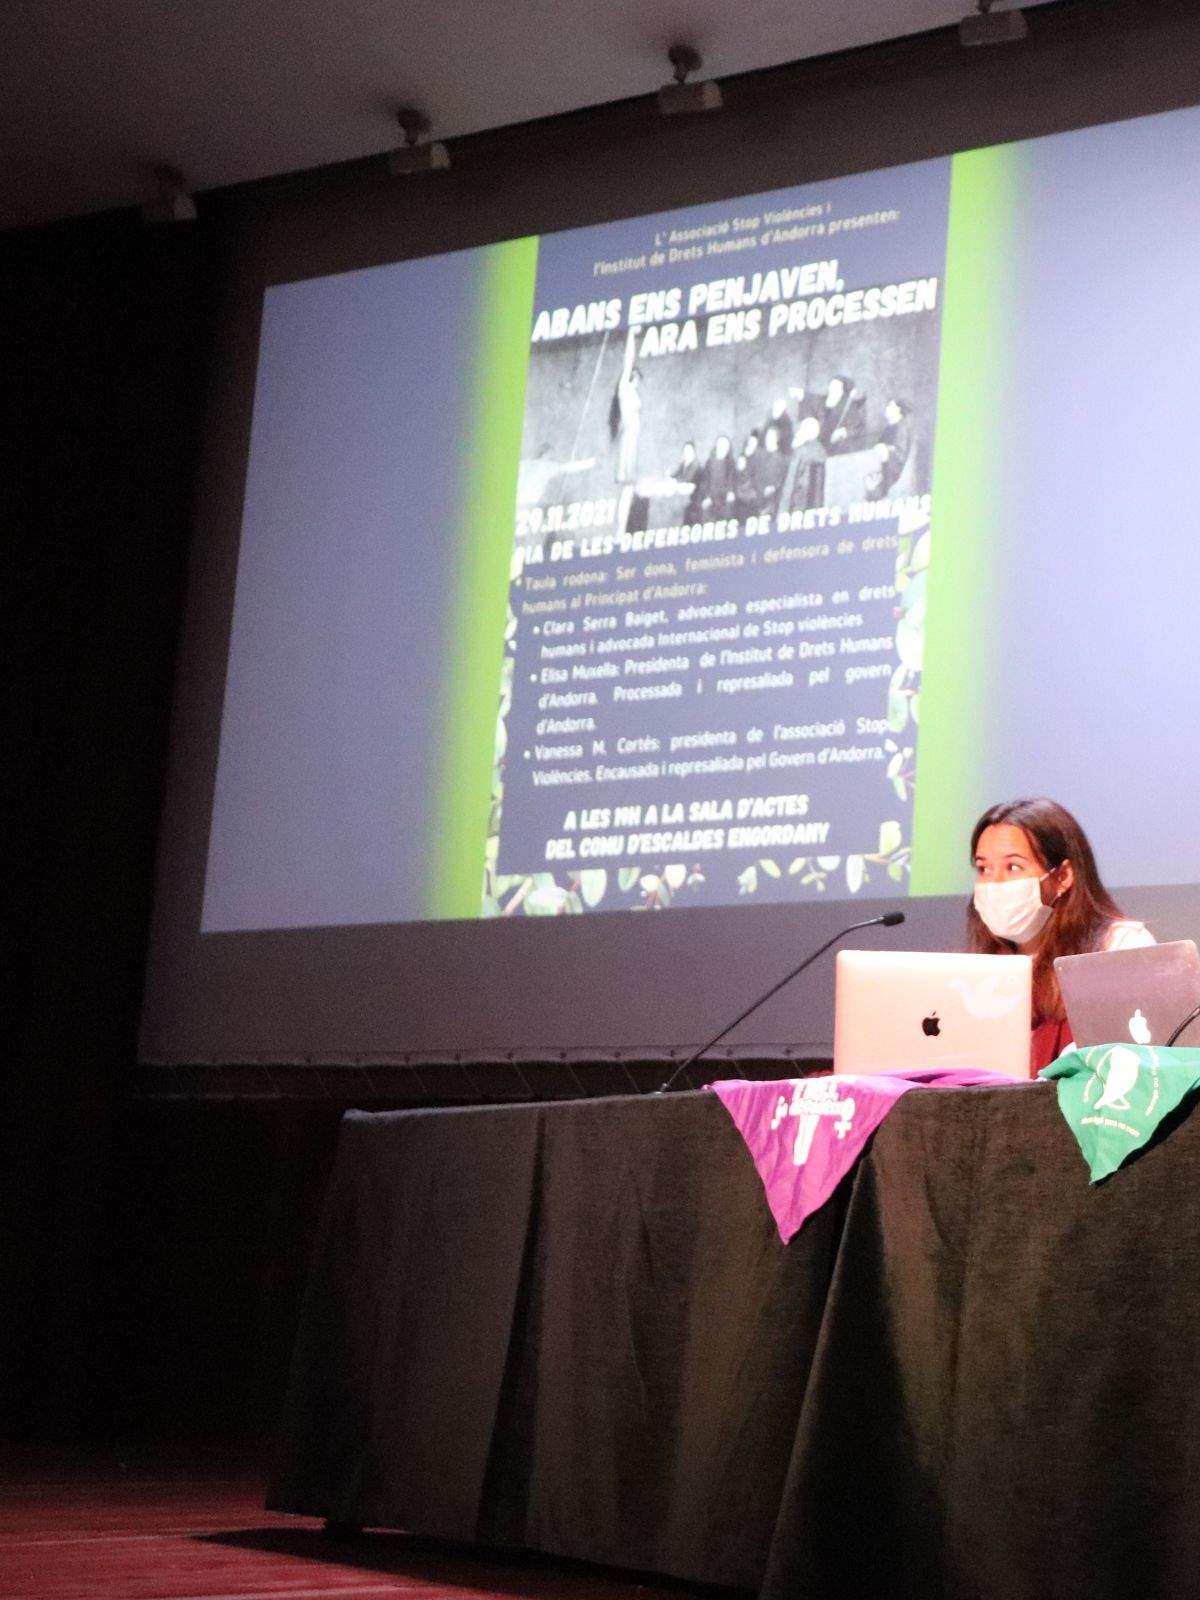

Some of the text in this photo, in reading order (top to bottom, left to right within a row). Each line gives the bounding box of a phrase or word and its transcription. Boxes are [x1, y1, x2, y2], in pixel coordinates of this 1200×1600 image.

[650, 250, 666, 268] de
[669, 243, 704, 265] Drets
[706, 234, 758, 258] Humans
[760, 220, 826, 248] d'Andorra
[669, 219, 730, 246] Associació
[732, 214, 761, 233] Stop
[531, 259, 845, 344] ABANS ENS PENJAVEN,
[638, 277, 939, 359] ARA ENS PROCESSEN
[550, 541, 574, 561] DE
[580, 535, 614, 557] LES
[618, 519, 739, 553] DEFENSORES
[744, 514, 770, 537] DE
[777, 505, 841, 532] DRETS
[525, 575, 557, 592] Taula
[616, 565, 636, 580] Ser
[685, 553, 745, 571] feminista
[763, 541, 831, 563] defensora
[837, 539, 855, 554] de
[862, 535, 899, 550] drets
[522, 597, 568, 614] humans
[571, 595, 582, 610] al
[585, 587, 641, 608] Principat
[543, 619, 575, 635] Clara
[582, 615, 618, 632] Serra
[677, 601, 737, 621] advocada
[746, 591, 824, 615] especialista
[832, 591, 849, 604] en
[858, 584, 895, 601] drets
[541, 642, 587, 659] humans
[598, 634, 655, 653] advocada
[743, 621, 760, 637] de
[763, 619, 794, 637] Stop
[541, 666, 569, 684] Elisa
[624, 655, 690, 675] Presidenta
[700, 652, 716, 668] de
[778, 643, 795, 660] de
[800, 640, 836, 658] Drets
[840, 634, 893, 654] Humans
[613, 681, 682, 701] Processada
[716, 671, 793, 692] represaliada
[809, 667, 829, 685] pel
[845, 663, 892, 682] govern
[535, 744, 583, 760] Vanessa
[670, 727, 737, 750] presidenta
[746, 726, 764, 743] de
[773, 719, 845, 740] l'associació
[856, 717, 890, 735] Stop
[595, 761, 659, 782] Encausada
[668, 754, 744, 778] represaliada
[746, 750, 766, 772] pel
[769, 749, 814, 768] Govern
[563, 811, 577, 831] A
[580, 808, 610, 829] LES
[644, 803, 658, 825] A
[662, 800, 685, 823] LA
[689, 797, 733, 820] SALA
[737, 794, 810, 818] D'ACTES
[545, 838, 576, 861] DEL
[627, 826, 725, 855] D'ESCALDES
[727, 822, 831, 848] ENGORDANY
